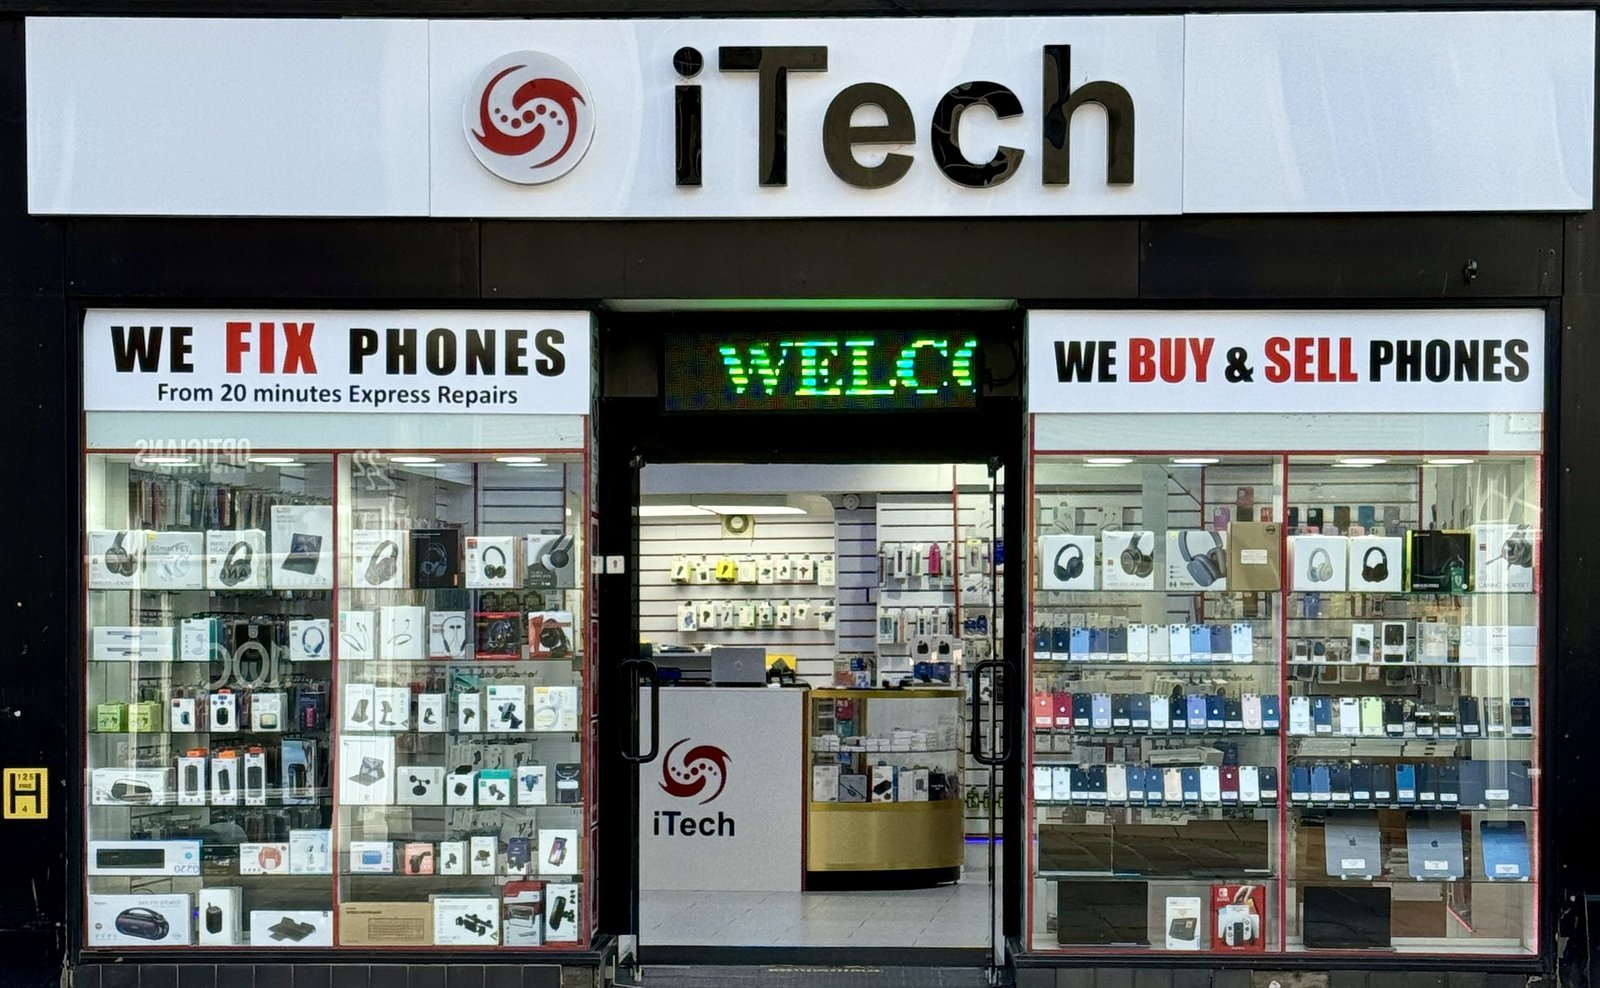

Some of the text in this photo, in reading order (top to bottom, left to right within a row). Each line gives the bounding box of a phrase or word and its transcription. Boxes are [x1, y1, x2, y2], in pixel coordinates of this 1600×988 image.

[673, 44, 1136, 190] iTech
[111, 322, 565, 376] WE FIX PHONES
[1054, 337, 1530, 384] WE BUY & SELL PHONES
[158, 383, 518, 408] From 20 minutes Express Repairs
[22, 805, 28, 813] 4
[653, 811, 735, 836] iTech
